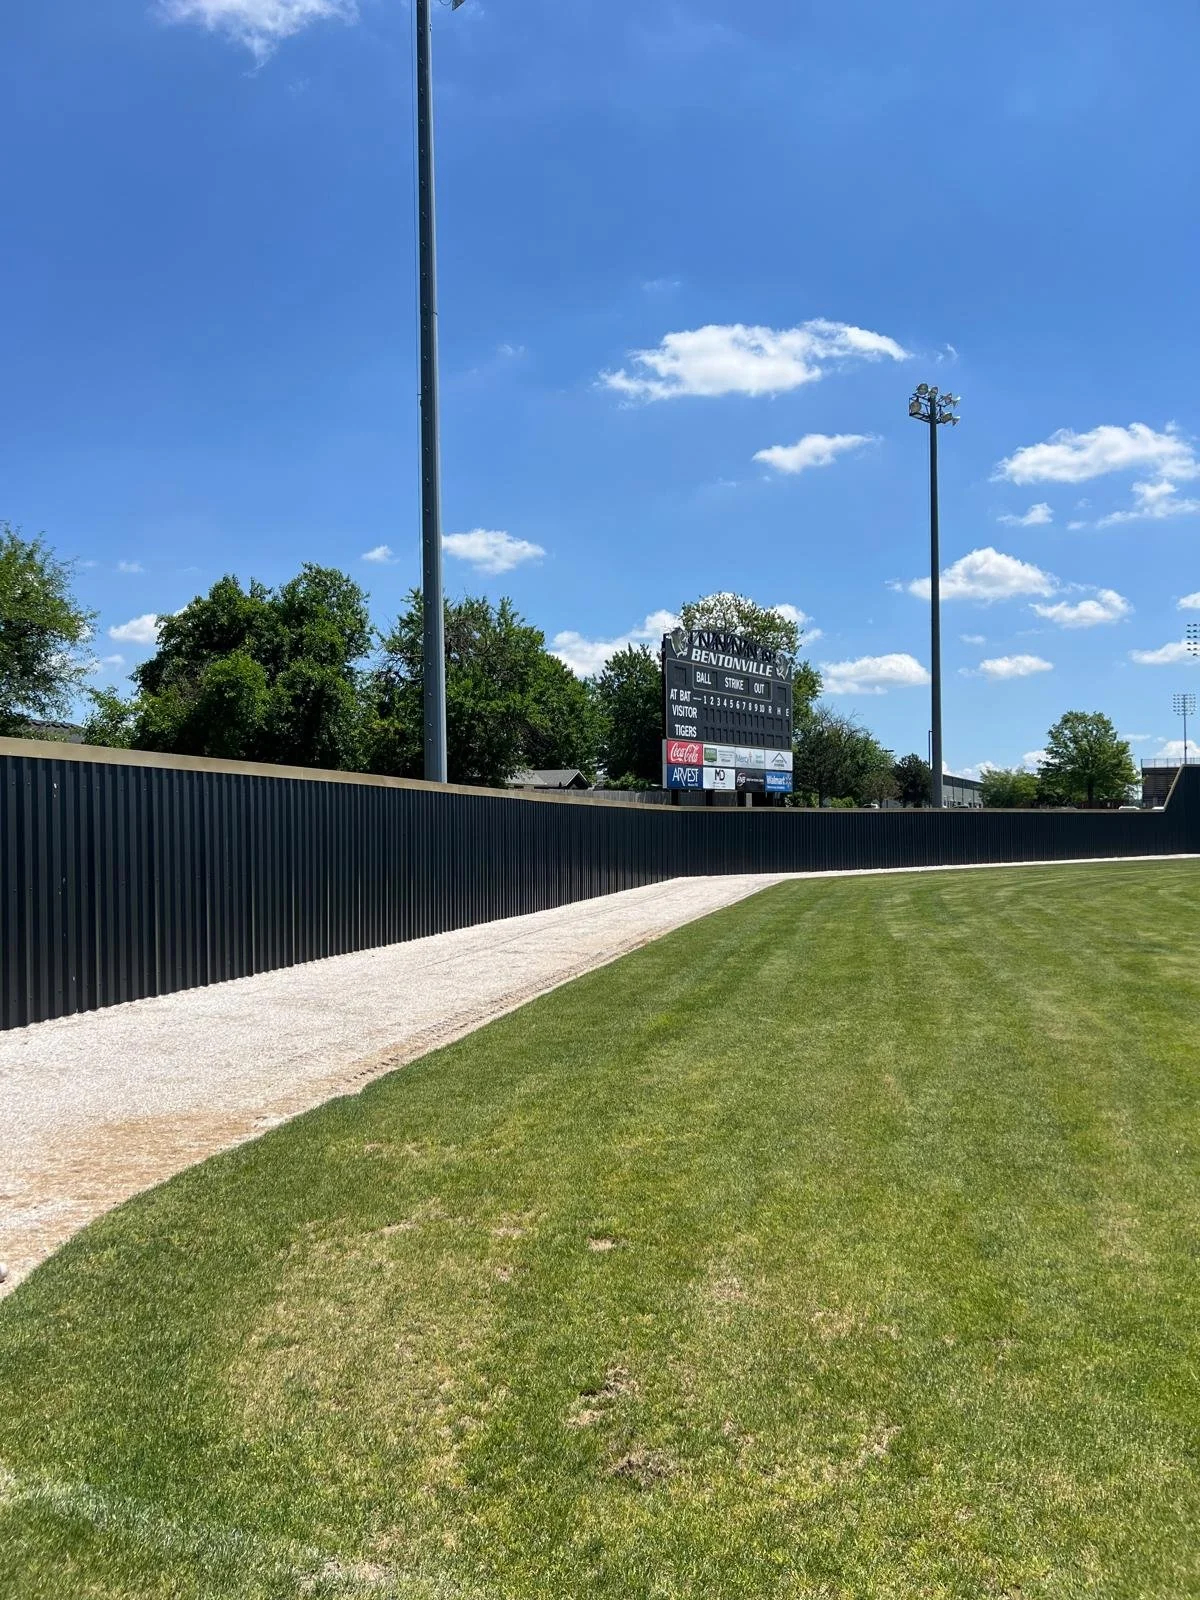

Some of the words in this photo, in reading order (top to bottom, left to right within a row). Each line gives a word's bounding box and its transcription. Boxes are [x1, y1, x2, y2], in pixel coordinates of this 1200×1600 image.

[691, 648, 774, 676] BENTONVILLE
[696, 671, 711, 685] BALL
[724, 676, 744, 690] STRIKE
[670, 688, 678, 700] AT
[679, 689, 691, 702] BAT
[753, 682, 764, 694] OUT
[672, 704, 698, 719] VISITOR
[703, 695, 707, 704] 1
[710, 696, 714, 704] 2
[716, 698, 720, 706] 3
[723, 698, 727, 707] 4
[730, 700, 734, 708] 5
[736, 700, 740, 709] 6
[742, 702, 746, 710] 7
[748, 702, 752, 710] 8
[754, 704, 758, 712] 9
[759, 704, 764, 712] 10
[768, 706, 772, 714] R
[786, 708, 789, 716] E
[674, 724, 697, 738] TIGERS
[672, 767, 699, 786] ARVEST
